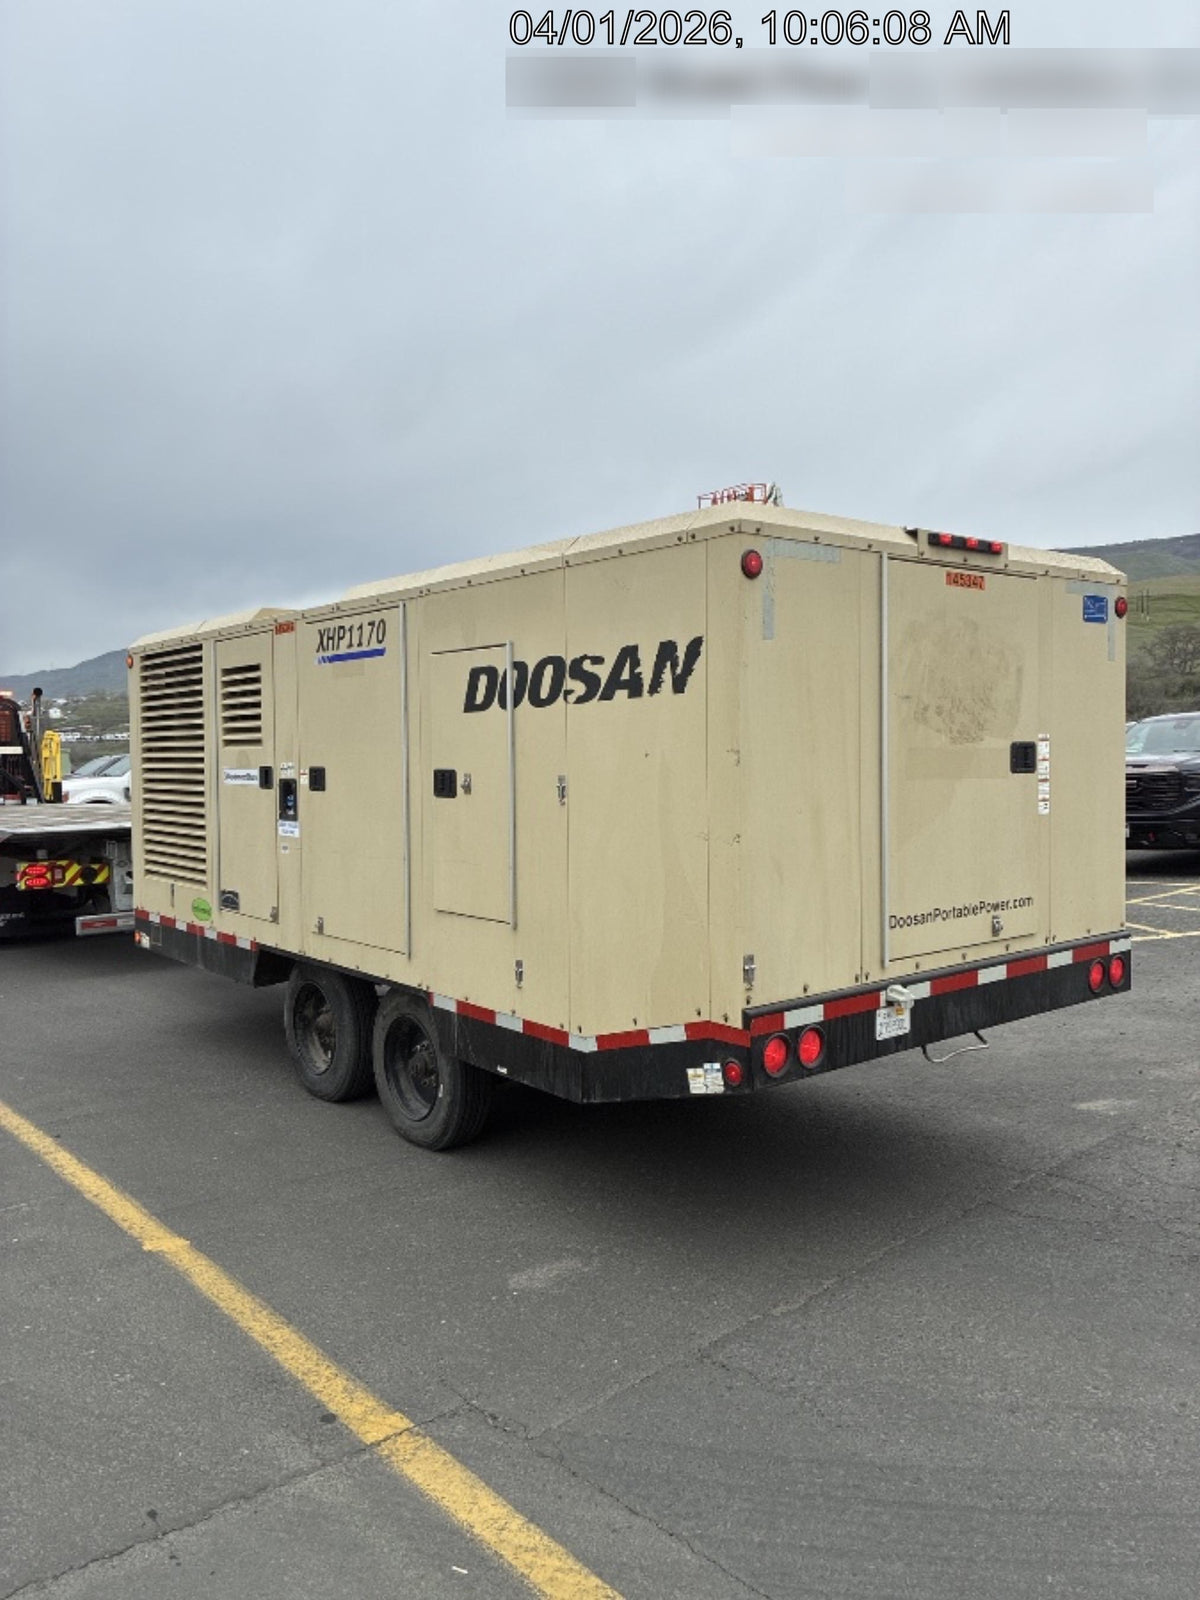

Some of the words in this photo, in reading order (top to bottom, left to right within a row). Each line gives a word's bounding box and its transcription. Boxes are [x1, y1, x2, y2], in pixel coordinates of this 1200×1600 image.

[316, 618, 387, 654] XHP1170
[463, 635, 704, 714] DOOSAN
[888, 896, 1034, 930] DoosanPortablePower.com
